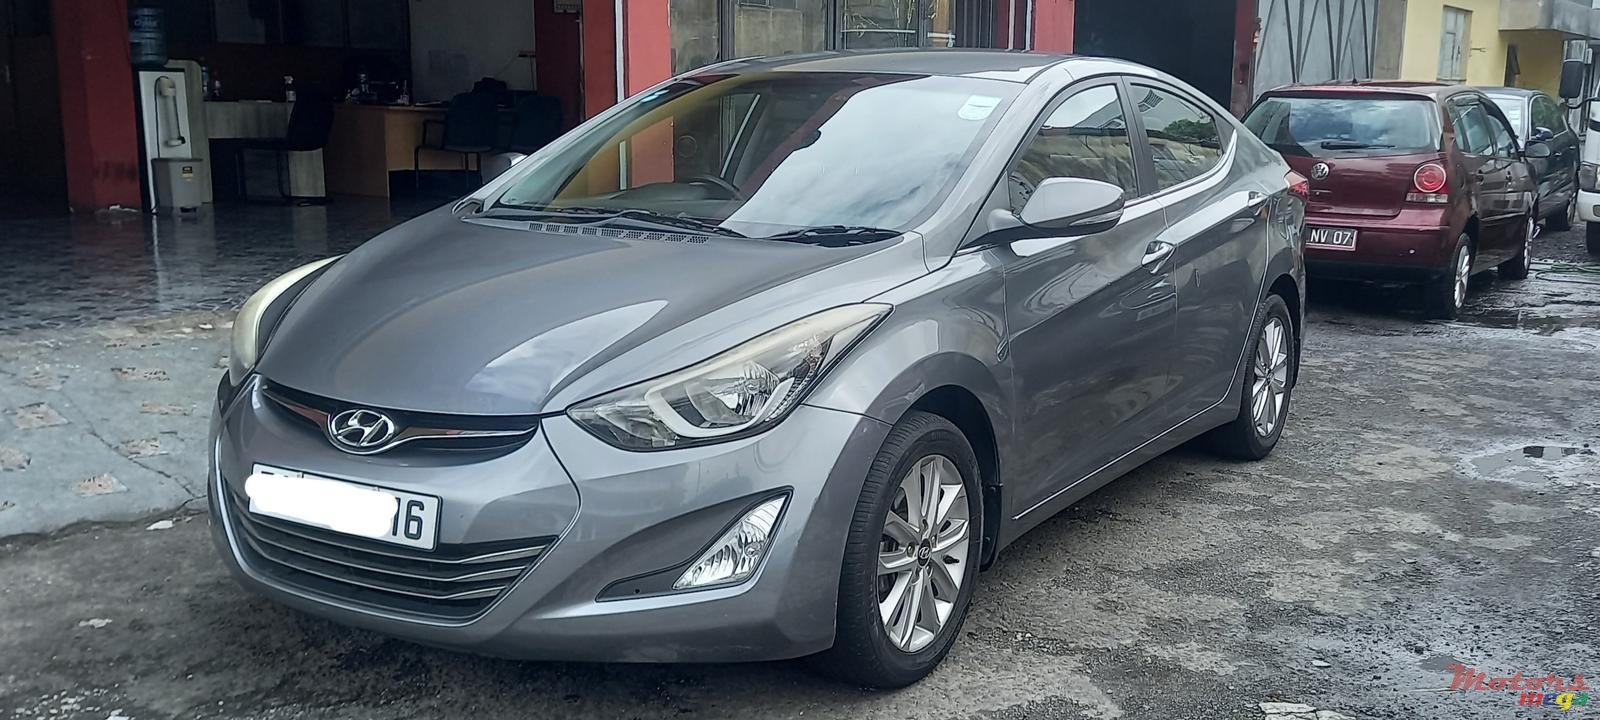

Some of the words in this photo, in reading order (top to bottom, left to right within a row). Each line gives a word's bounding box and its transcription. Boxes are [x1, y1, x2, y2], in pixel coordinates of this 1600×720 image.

[1311, 229, 1328, 242] NV
[1333, 231, 1351, 244] 07
[392, 497, 425, 540] 16
